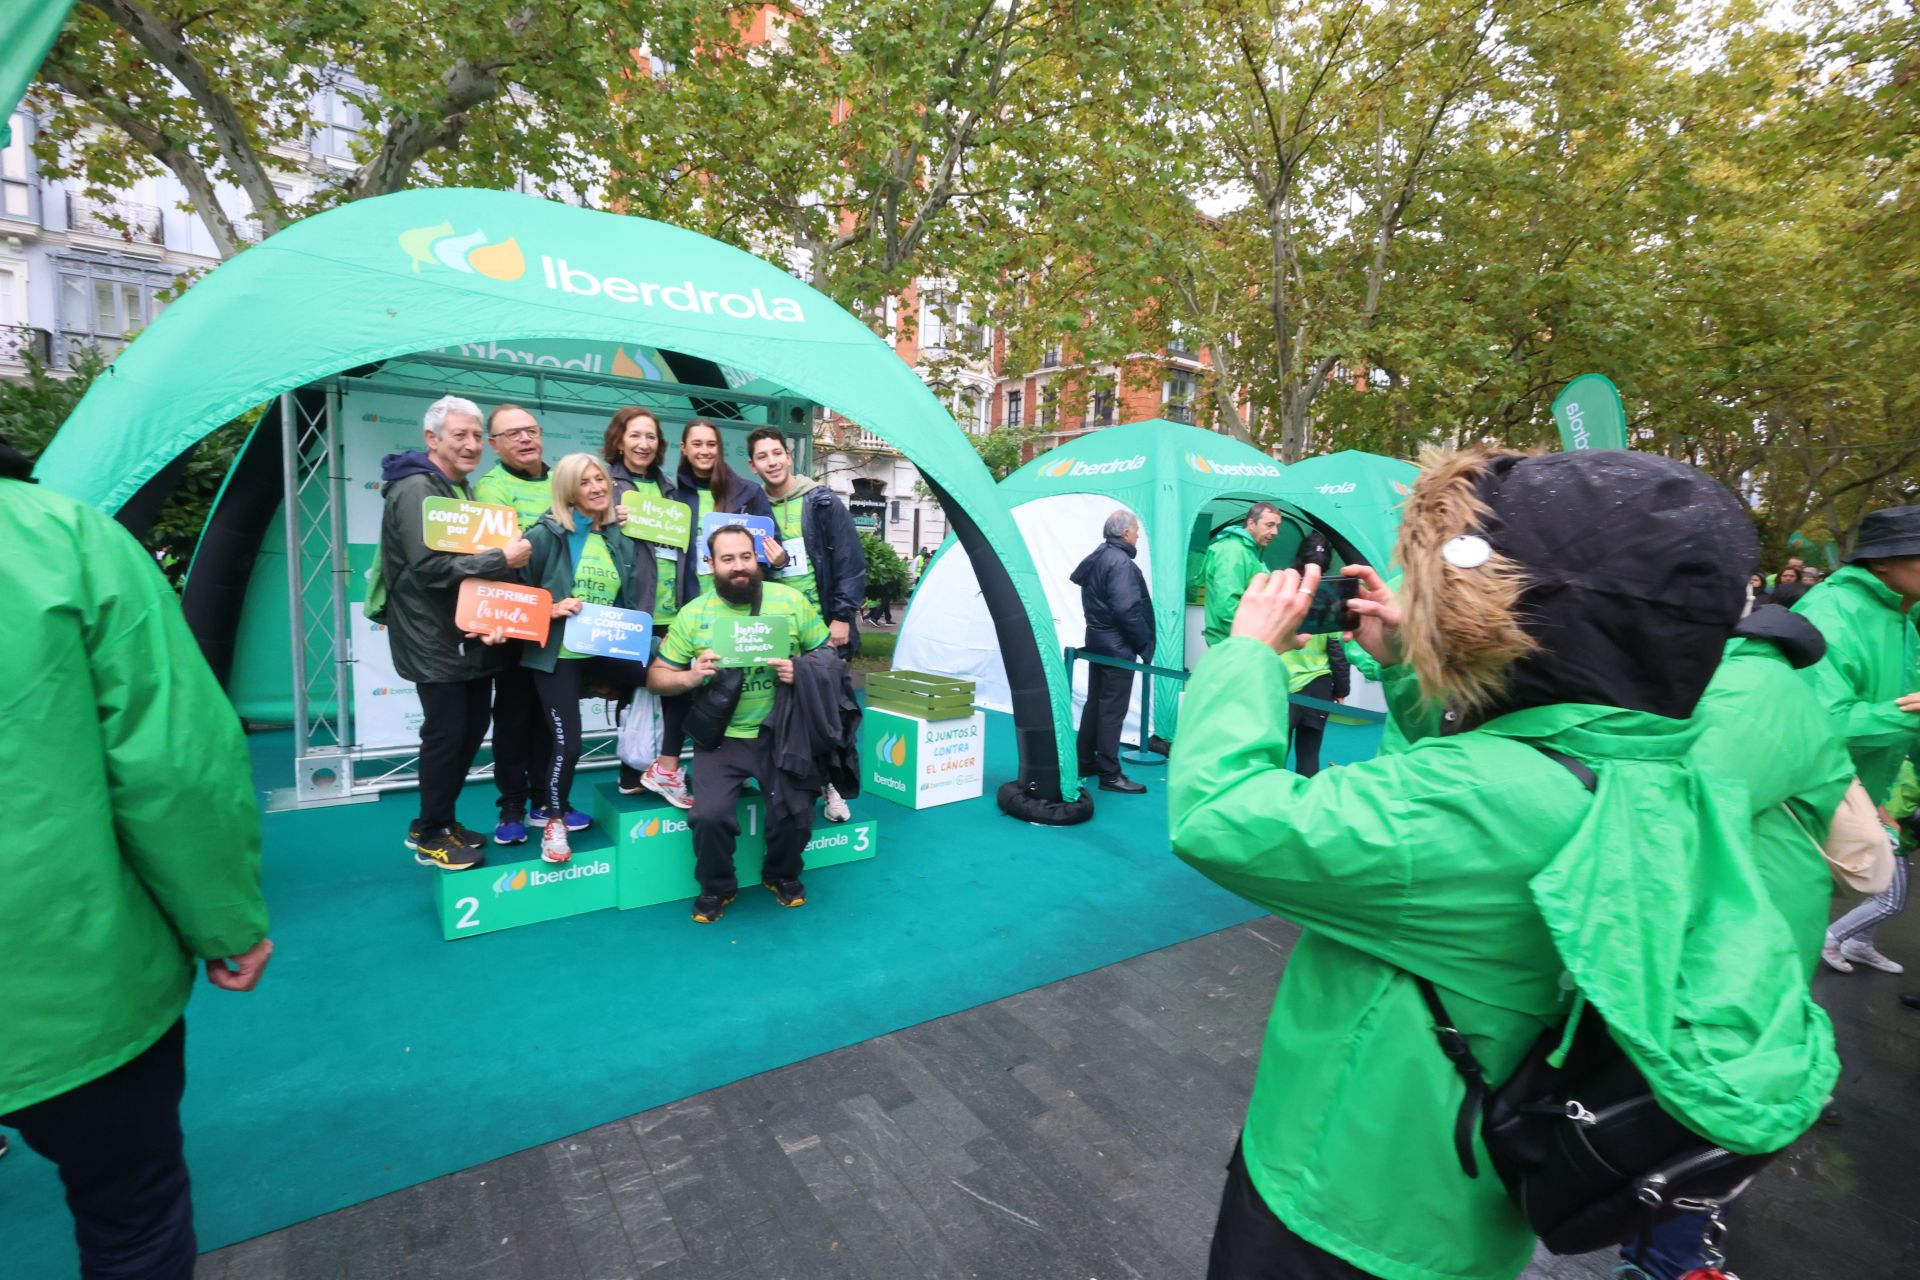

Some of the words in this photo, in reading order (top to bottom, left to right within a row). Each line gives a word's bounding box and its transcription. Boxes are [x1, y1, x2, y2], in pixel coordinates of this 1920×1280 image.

[541, 255, 805, 322] Iberdrola
[1068, 454, 1147, 477] Iberdrola
[1211, 459, 1280, 477] Iberdrola
[428, 509, 470, 525] corro
[459, 503, 483, 516] Hoy
[472, 509, 514, 543] Mi
[627, 513, 663, 529] NUNCA
[728, 517, 748, 526] HOY
[447, 525, 469, 536] por
[477, 585, 539, 606] EXPRIME
[477, 599, 492, 618] la
[599, 610, 624, 620] HOY
[594, 618, 644, 633] CORRIDO
[935, 728, 969, 741] JUNTOS
[933, 742, 970, 757] CONTRA
[926, 765, 937, 774] EL
[873, 771, 906, 792] Iberdrola
[662, 819, 690, 834] Ibe
[746, 804, 758, 836] 1
[852, 826, 870, 852] 3
[529, 860, 611, 887] Iberdrola
[454, 896, 481, 929] 2
